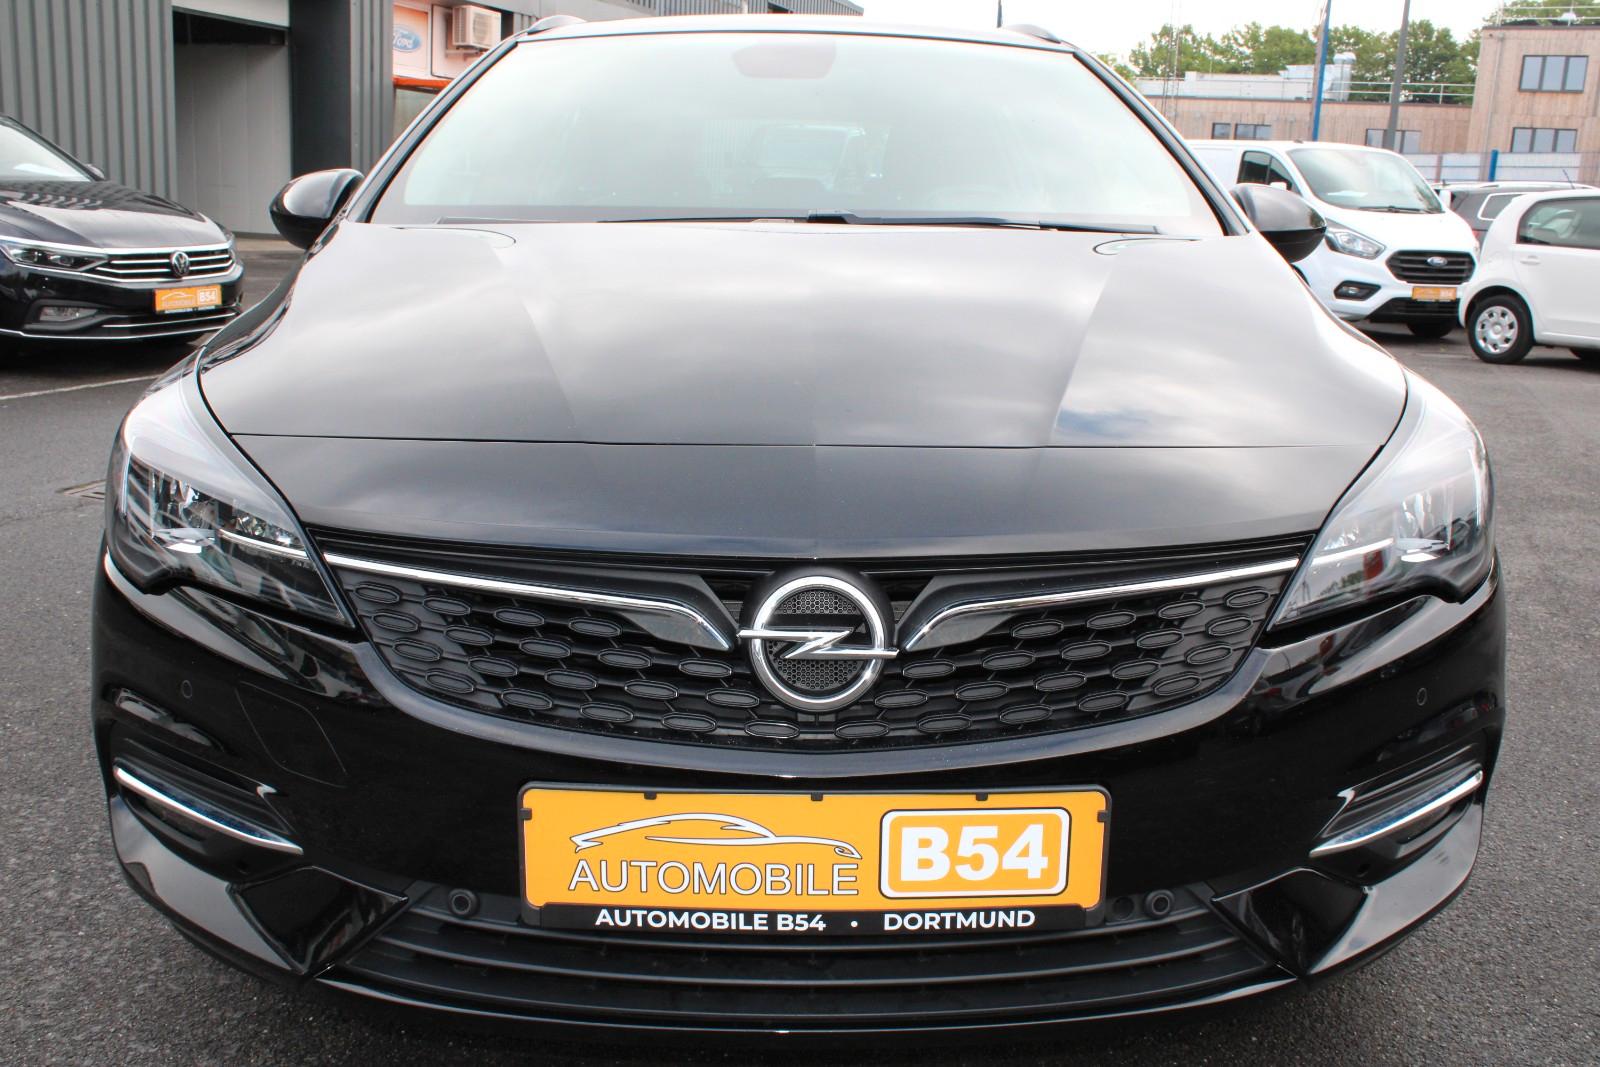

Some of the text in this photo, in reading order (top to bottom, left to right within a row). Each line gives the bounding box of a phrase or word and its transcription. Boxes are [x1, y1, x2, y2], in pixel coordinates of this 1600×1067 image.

[900, 824, 1048, 881] B54
[568, 859, 859, 896] AUTOMOBILE
[595, 908, 1035, 931] AUTOMOBILE B54 DORTMUND
